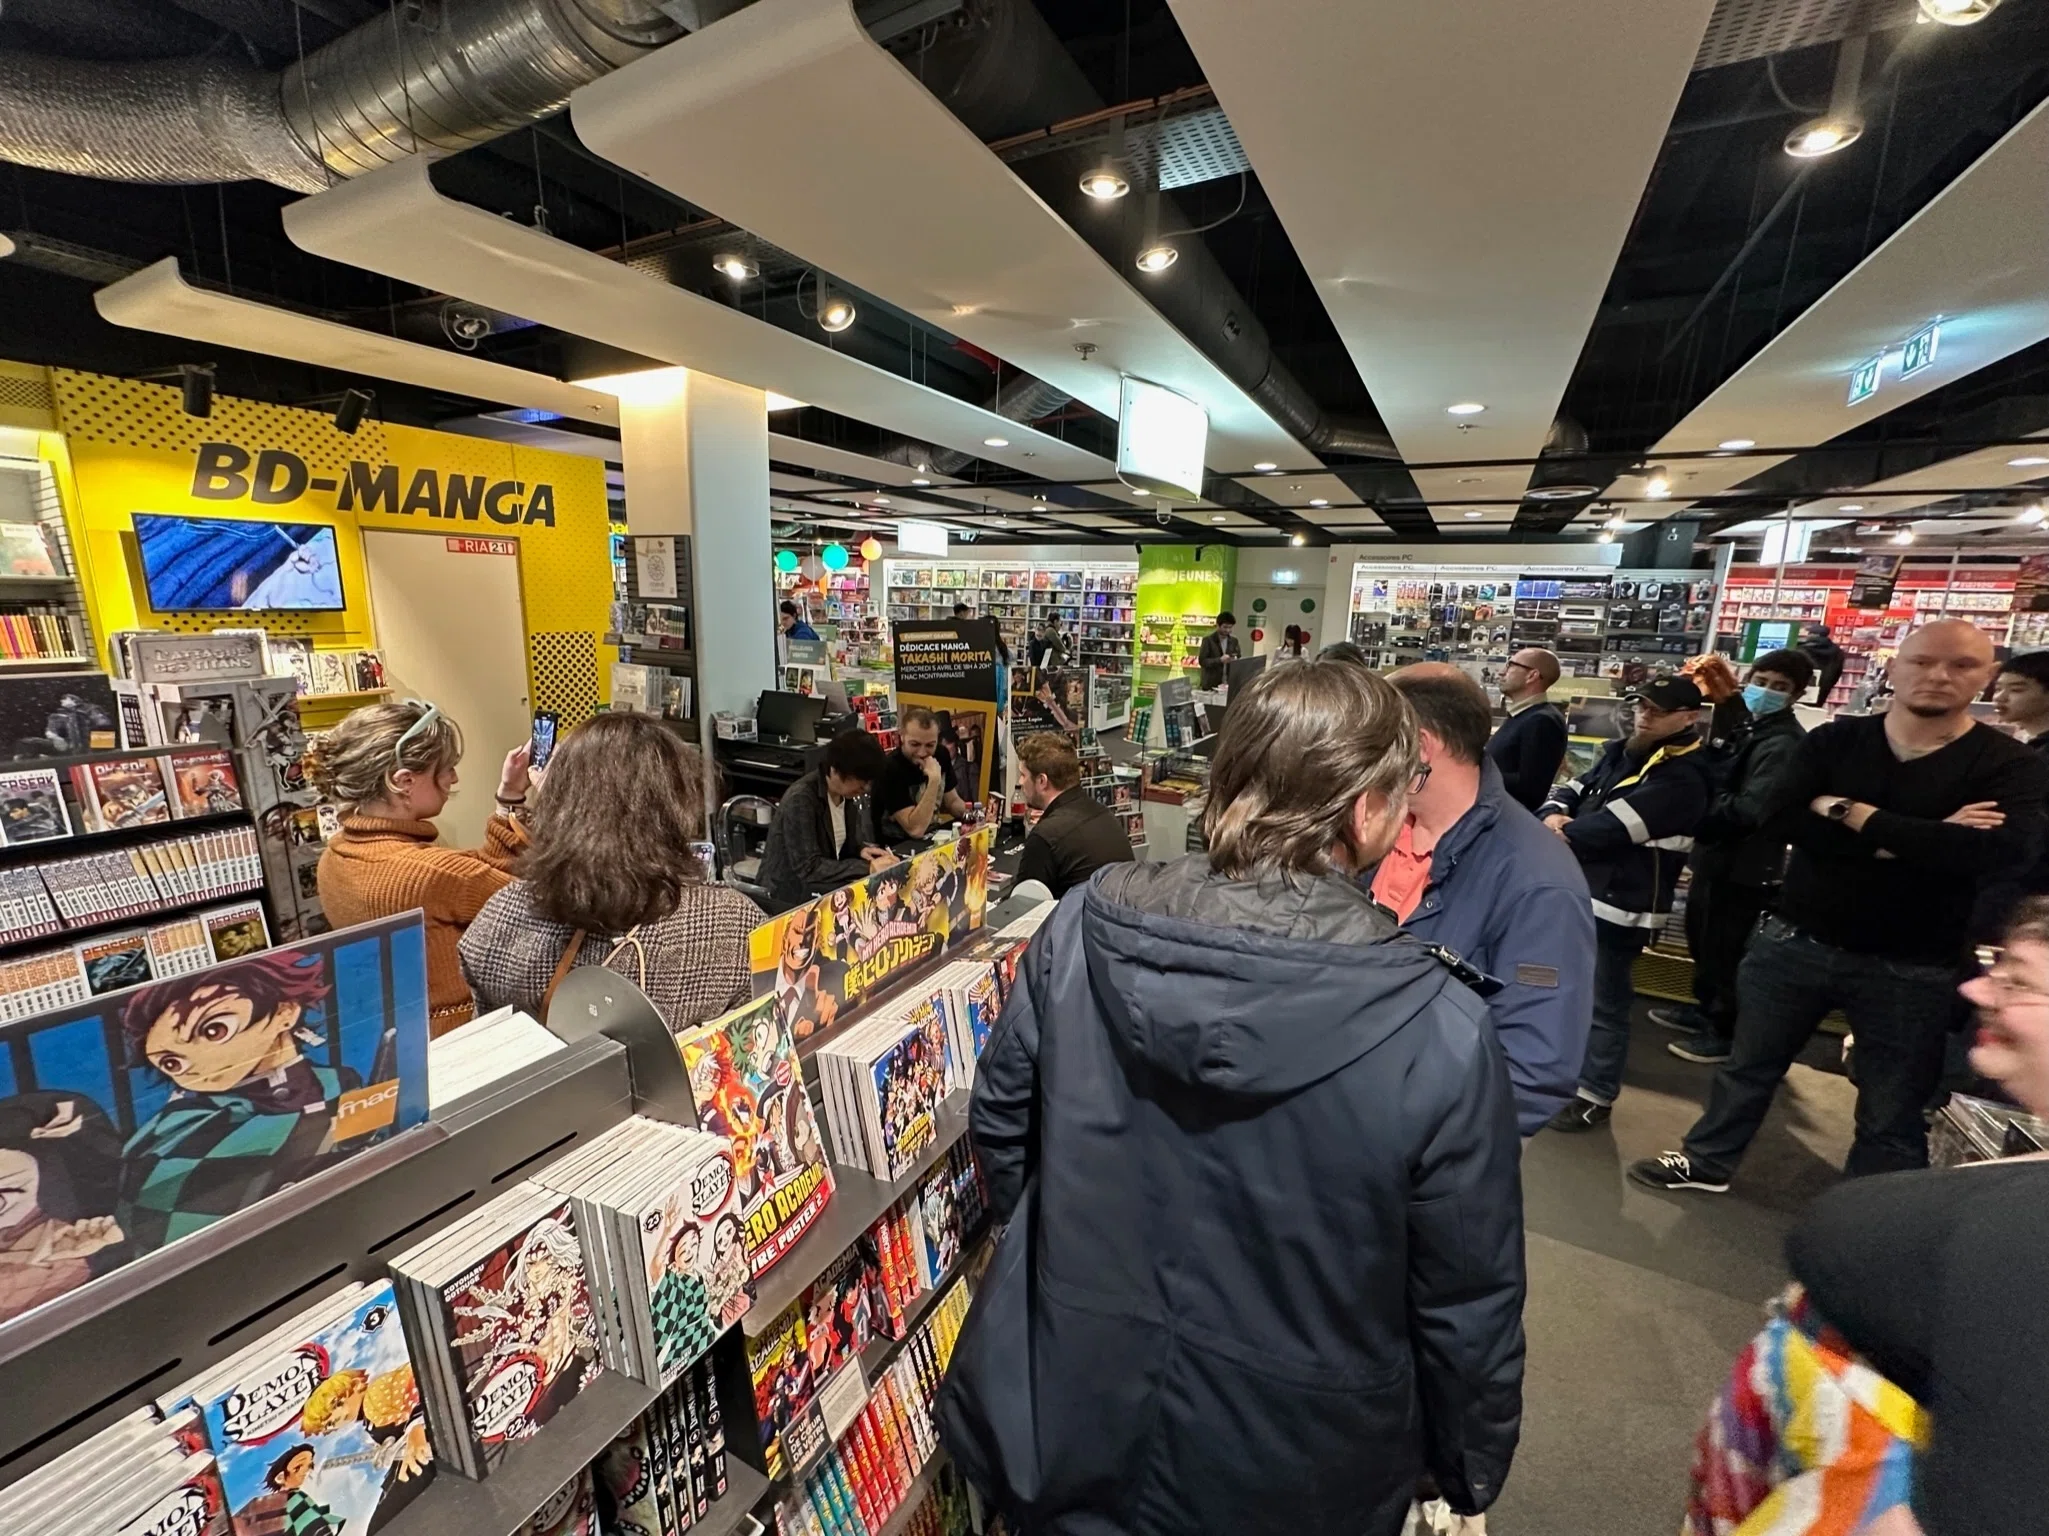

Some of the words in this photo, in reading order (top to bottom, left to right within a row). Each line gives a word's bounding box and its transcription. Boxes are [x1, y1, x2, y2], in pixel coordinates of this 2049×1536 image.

[191, 441, 555, 528] BD-MANGA
[491, 542, 505, 553] 21
[900, 642, 940, 652] DÉDICACE
[941, 642, 970, 651] MANGA
[901, 652, 948, 665] TAKASHI
[951, 650, 992, 663] MORITA
[155, 662, 189, 675] DES
[195, 657, 252, 672] TITANS
[901, 665, 932, 673] MERCREDI
[901, 672, 918, 680] FNAC
[918, 671, 965, 680] MONTPARNASSE
[0, 775, 54, 793] ERSERK
[862, 941, 874, 961] MY
[873, 924, 889, 952] HERO
[889, 921, 918, 938] ACADEMIA
[339, 1084, 399, 1119] fnac
[690, 1155, 732, 1199] DEMON
[692, 1166, 735, 1217] SLAYER
[646, 1212, 661, 1231] 23
[744, 1199, 778, 1251] ERO
[777, 1201, 817, 1250] POSTER
[816, 1192, 824, 1207] 2
[443, 1263, 485, 1296] KOYOHARU
[445, 1273, 481, 1303] GOTOUGE
[813, 1242, 860, 1301] ACADEMIA
[370, 1311, 380, 1326] 3
[218, 1351, 322, 1423] DEMON
[222, 1364, 328, 1447] SLAYER
[468, 1361, 537, 1419] DEMON
[472, 1371, 543, 1440] SLAYER
[507, 1417, 523, 1438] 22
[790, 1439, 801, 1453] DE
[800, 1414, 821, 1440] CŒUR
[793, 1448, 803, 1462] DE
[803, 1421, 826, 1449] VOTRE
